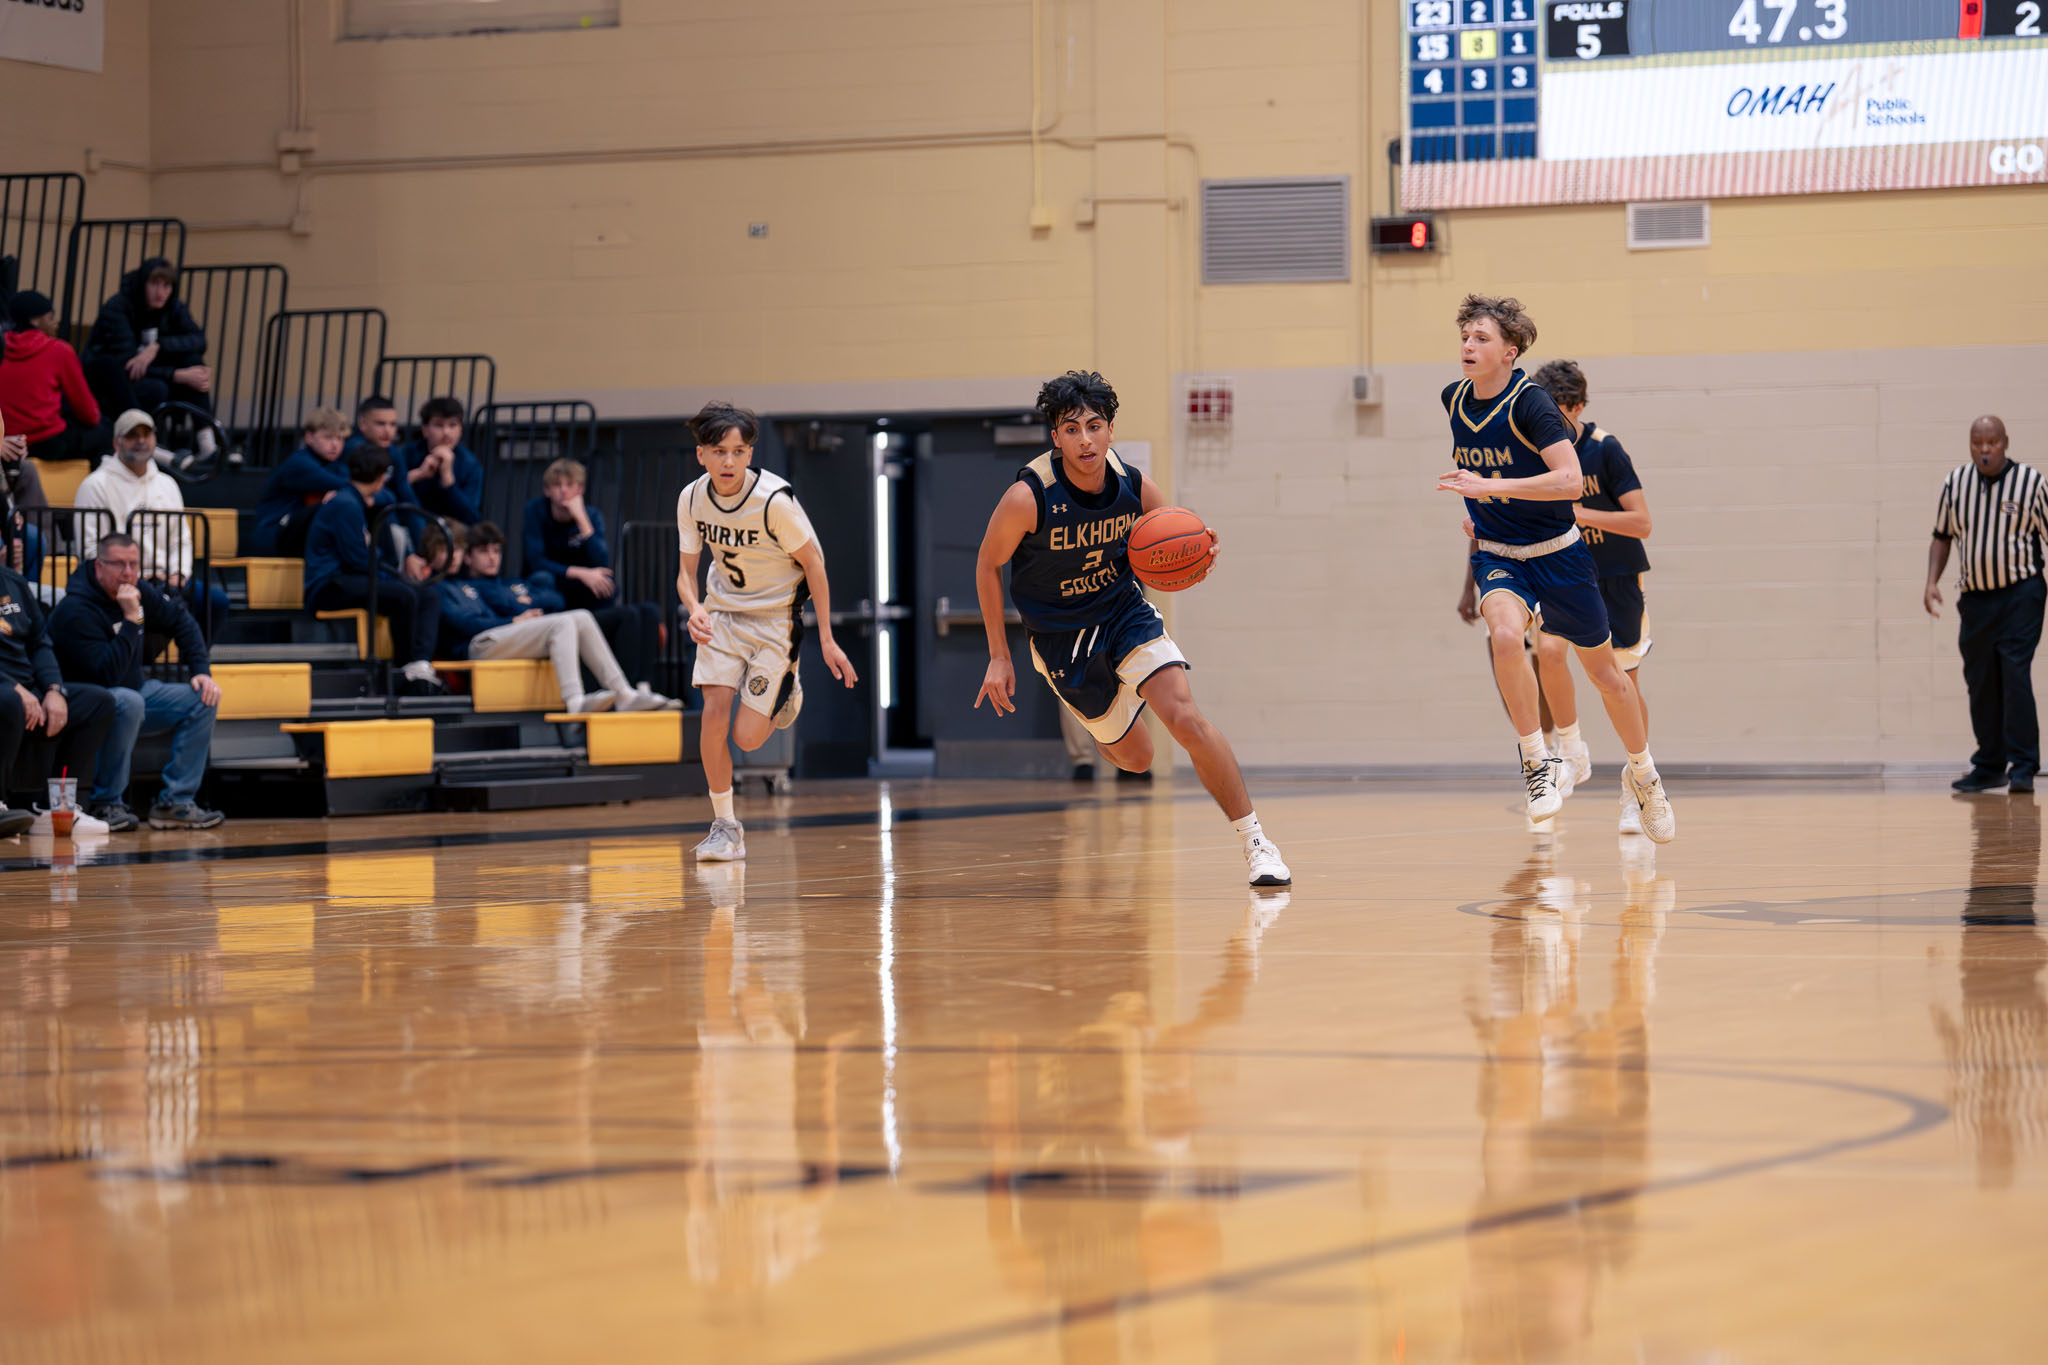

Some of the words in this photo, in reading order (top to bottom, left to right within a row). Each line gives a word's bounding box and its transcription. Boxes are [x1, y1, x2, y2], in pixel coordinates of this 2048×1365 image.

[1470, 1, 1487, 22] 2
[1511, 1, 1527, 20] 1
[1554, 2, 1623, 21] FOULS
[1728, 0, 1848, 44] 47.3
[2014, 1, 2041, 36] 2
[1417, 34, 1449, 61] 15
[1511, 32, 1527, 54] 1
[1576, 24, 1602, 60] 5
[1423, 68, 1444, 94] 4
[1470, 68, 1487, 90] 3
[1511, 66, 1528, 88] 3
[1866, 98, 1910, 111] Public
[1866, 112, 1925, 126] Schools
[1989, 144, 2044, 175] GO
[696, 520, 760, 547] BURKE
[1050, 512, 1136, 551] ELKHORN
[720, 549, 746, 589] 5
[1149, 542, 1201, 567] Baden
[1059, 560, 1119, 597] SOUTH
